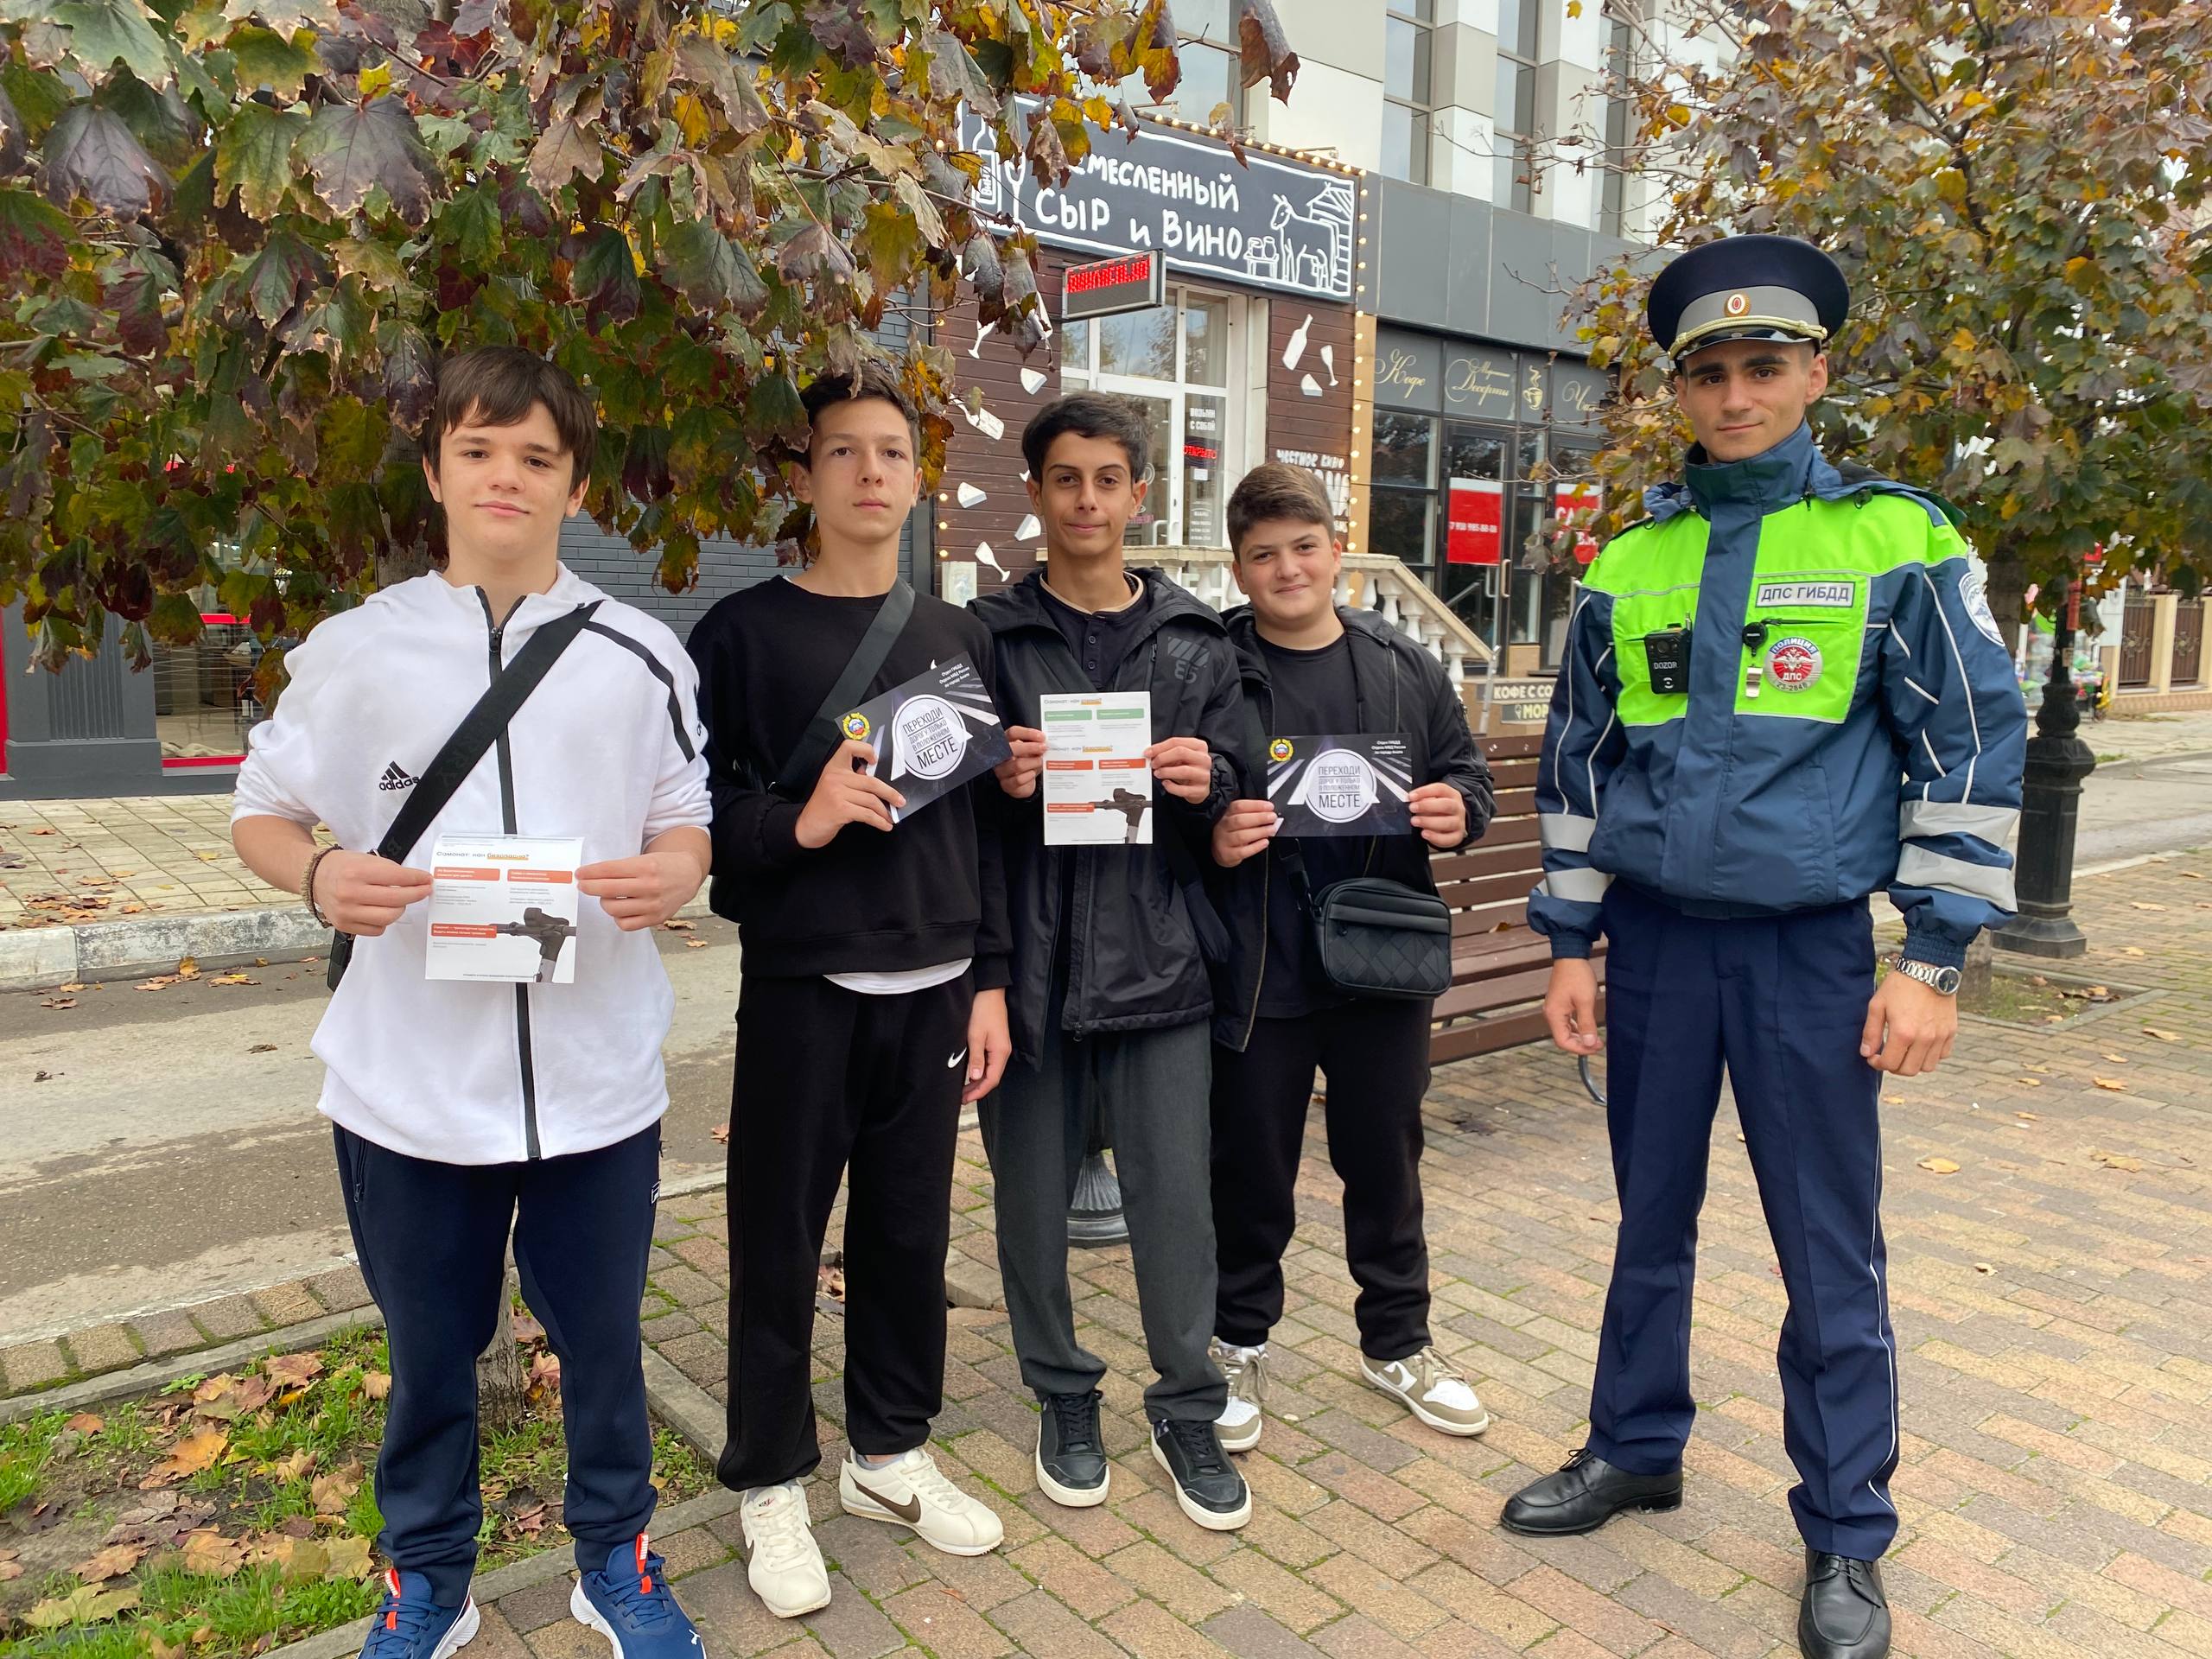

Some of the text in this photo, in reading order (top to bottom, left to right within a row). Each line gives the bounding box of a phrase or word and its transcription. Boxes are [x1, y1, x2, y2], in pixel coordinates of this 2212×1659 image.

[1068, 153, 1240, 213] МЕСЛЕННЫЙ
[1375, 348, 1426, 398] Кофе
[1761, 585, 1850, 602] ДПС ГИБДД
[1771, 637, 1817, 654] ПОЛИЦИЯ
[1653, 661, 1678, 671] DOZOR
[1783, 671, 1802, 682] ДПС
[1493, 683, 1553, 700] КОФЕ С СО
[1522, 703, 1549, 719] МОР
[902, 706, 944, 734] ПЕРЕХОДИ
[909, 719, 948, 745] ДОРОГУ ТОЛЬКО
[916, 727, 950, 749] ПОЛОЖЕННОМ
[917, 736, 958, 770] МЕСТЕ
[1318, 766, 1361, 776] ПЕРЕХОДИ
[378, 776, 420, 791] adidas
[1319, 793, 1361, 808] МЕСТЕ
